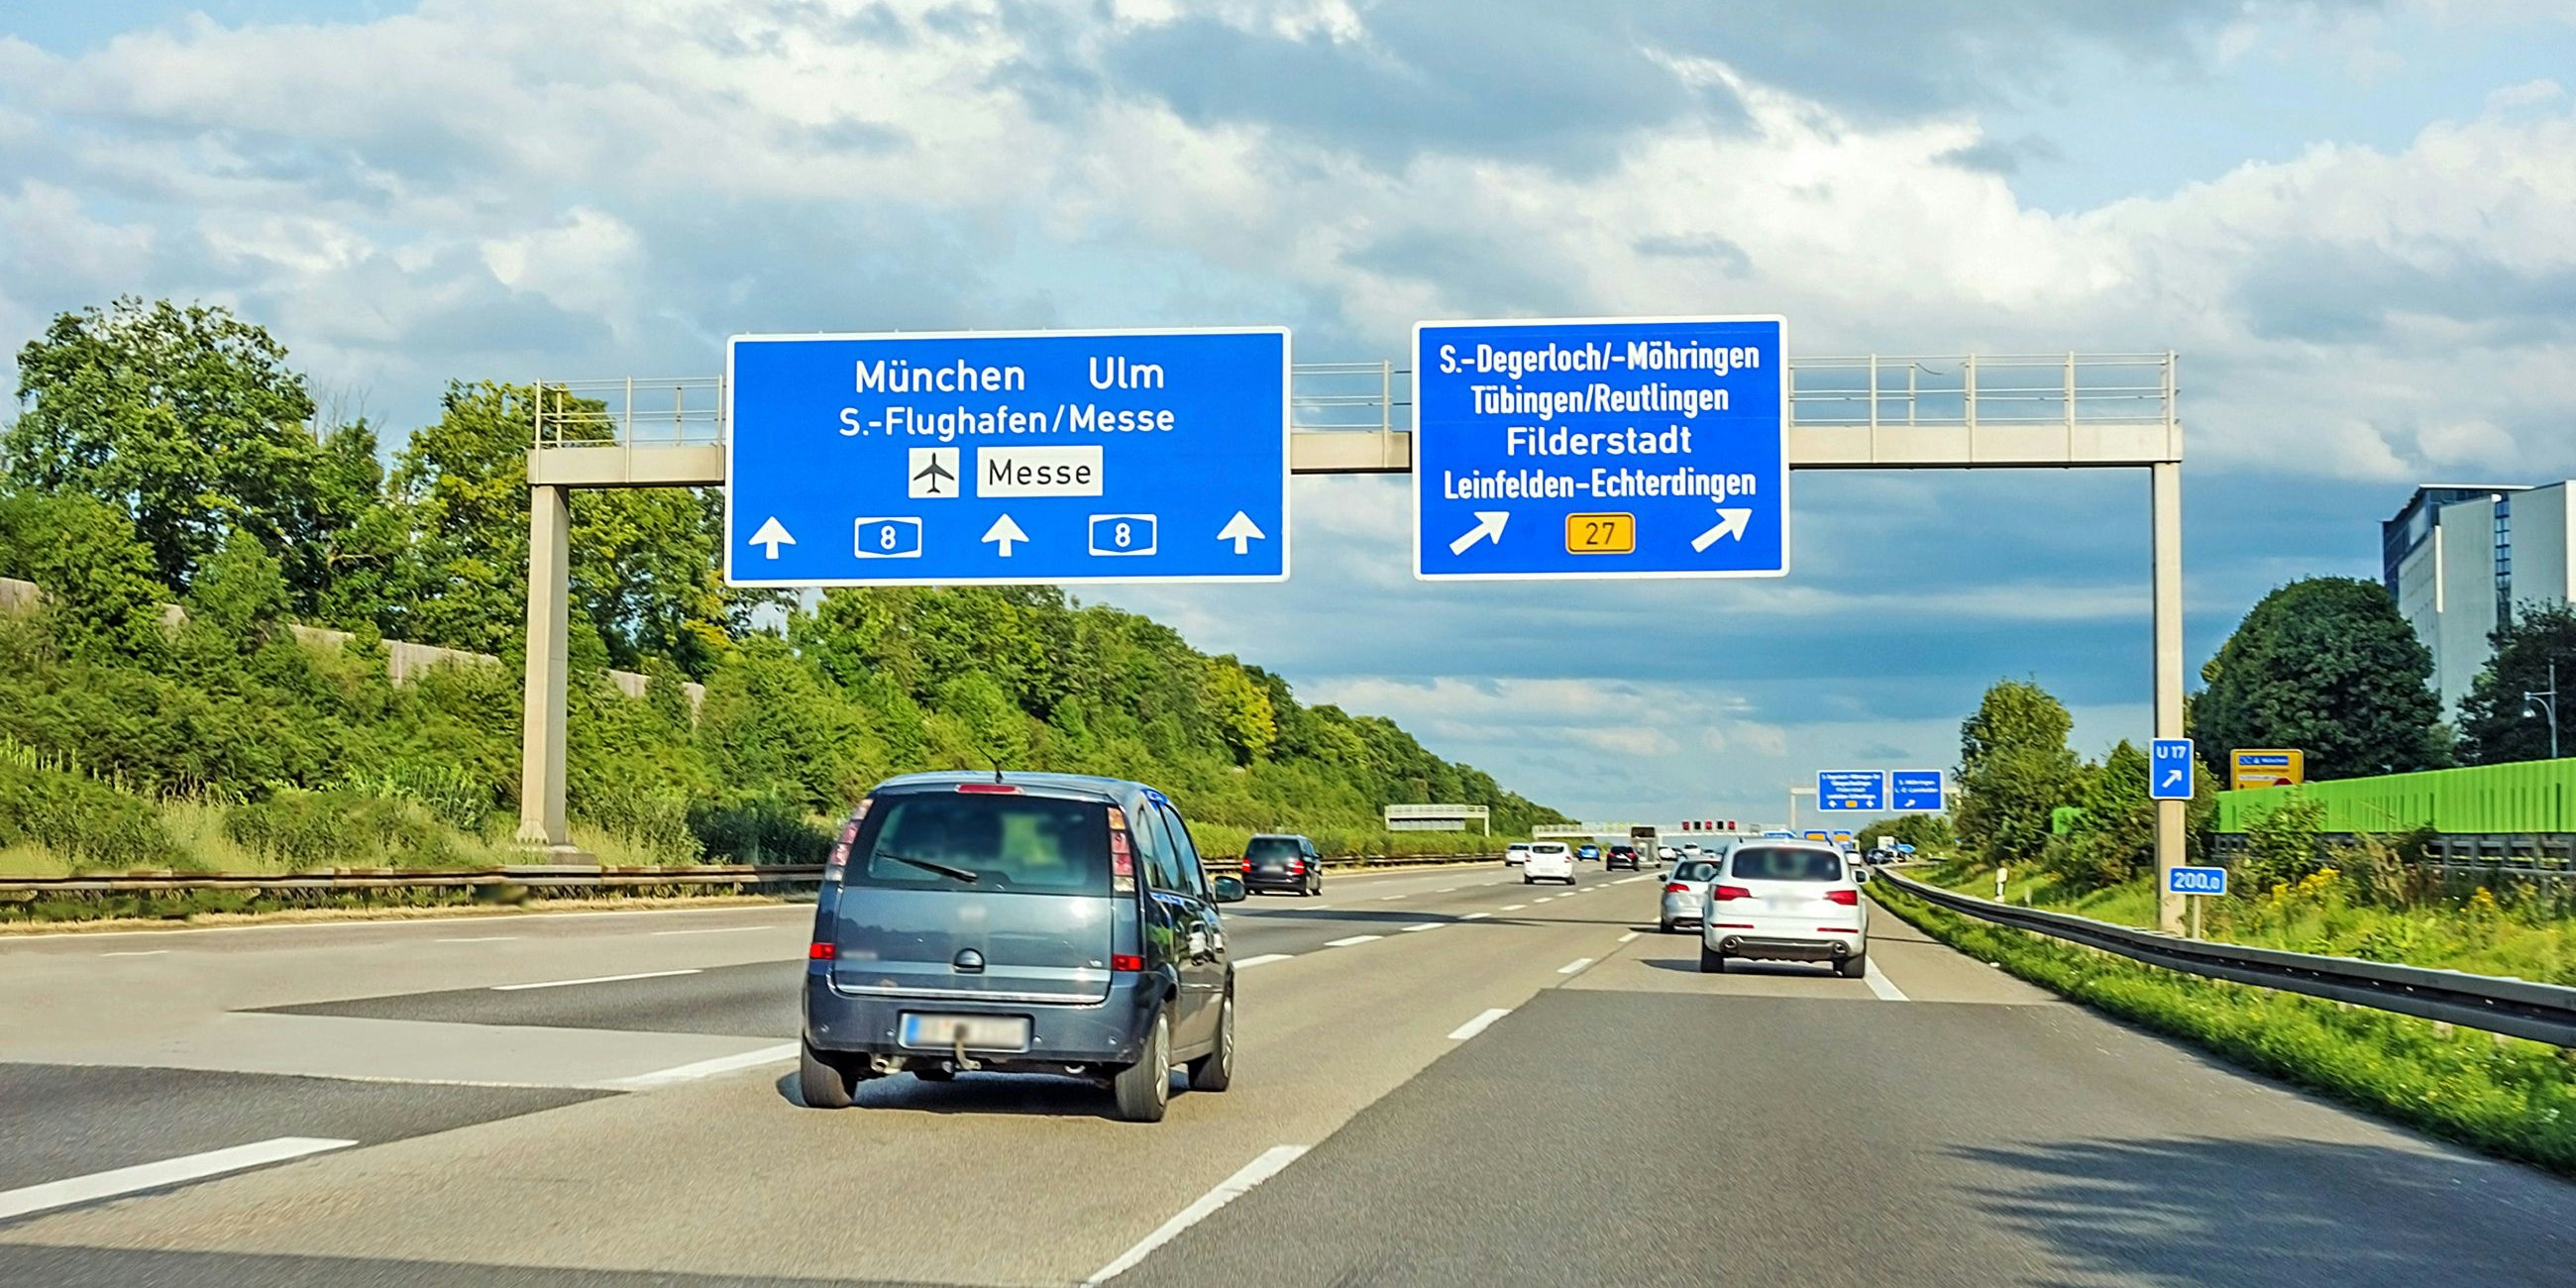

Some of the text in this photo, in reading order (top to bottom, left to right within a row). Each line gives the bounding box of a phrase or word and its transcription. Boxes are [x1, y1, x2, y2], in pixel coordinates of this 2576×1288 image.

[856, 356, 1164, 393] München Ulm
[1440, 340, 1760, 380] S.-Degerloch/-Möhringen
[1470, 381, 1729, 421] Tübingen/Reutlingen
[839, 403, 1175, 443] S.-Flughafen/Messe
[1507, 424, 1692, 456] Filderstadt
[989, 459, 1091, 485] Messe
[1444, 467, 1757, 503] Leinfelden-Echterdingen
[879, 525, 897, 551] 8
[1114, 522, 1131, 548] 8
[1585, 522, 1616, 546] 27
[2157, 745, 2187, 759] U 17
